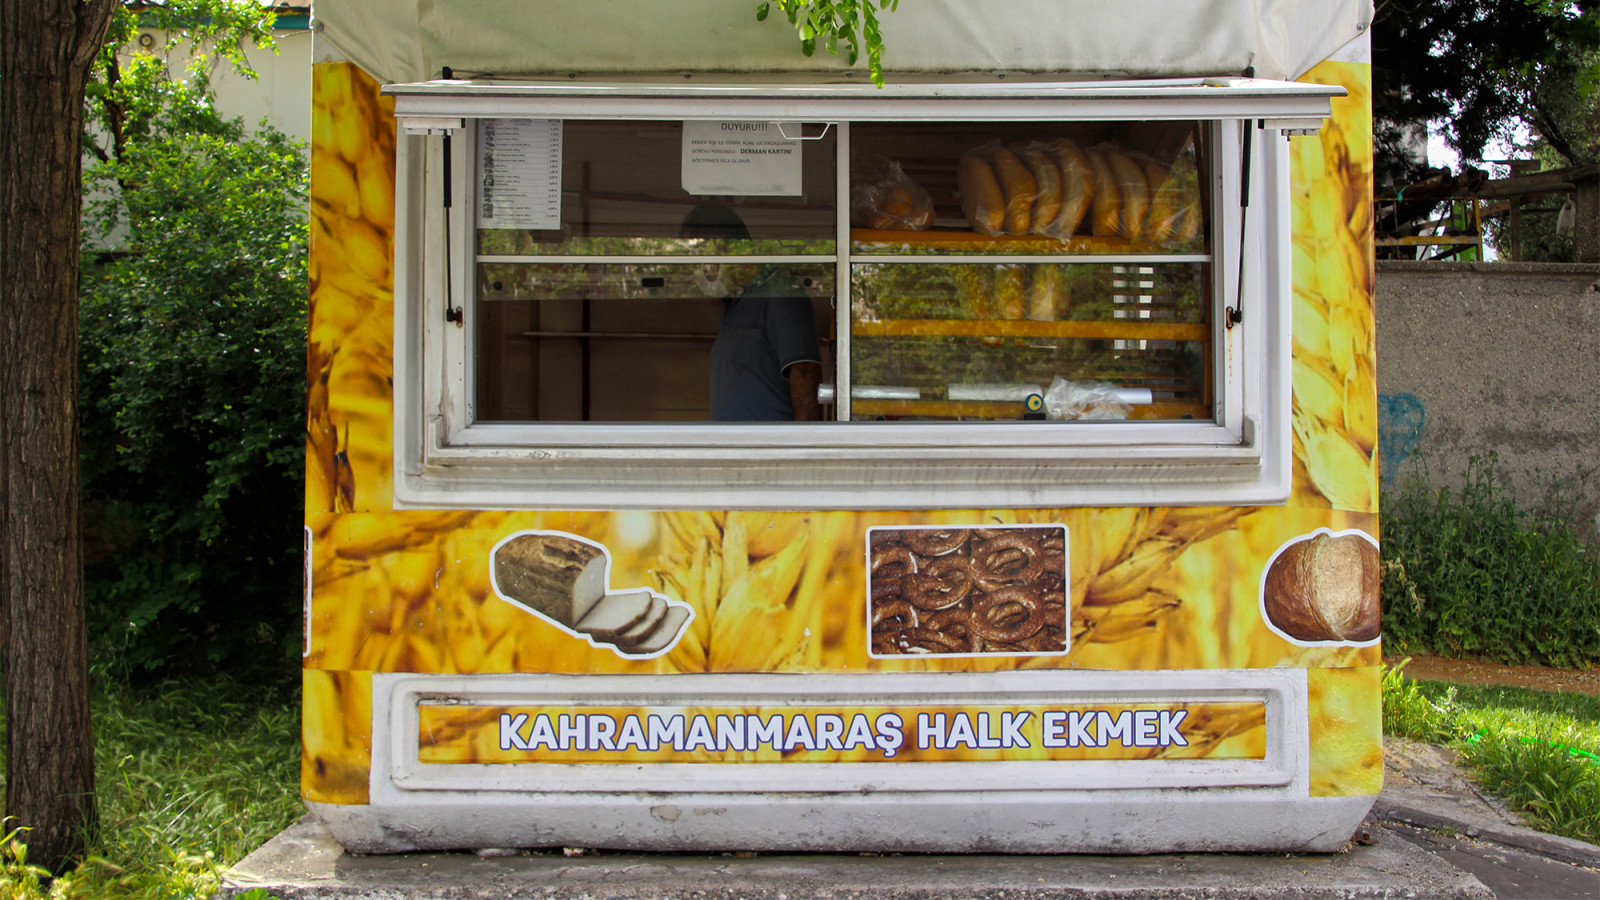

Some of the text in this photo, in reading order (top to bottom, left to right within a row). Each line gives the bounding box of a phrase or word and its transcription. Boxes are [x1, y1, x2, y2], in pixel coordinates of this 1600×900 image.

[721, 122, 768, 131] DUYURU!!!
[499, 709, 1188, 757] KAHRAMANMARAŞ HALK EKMEK
